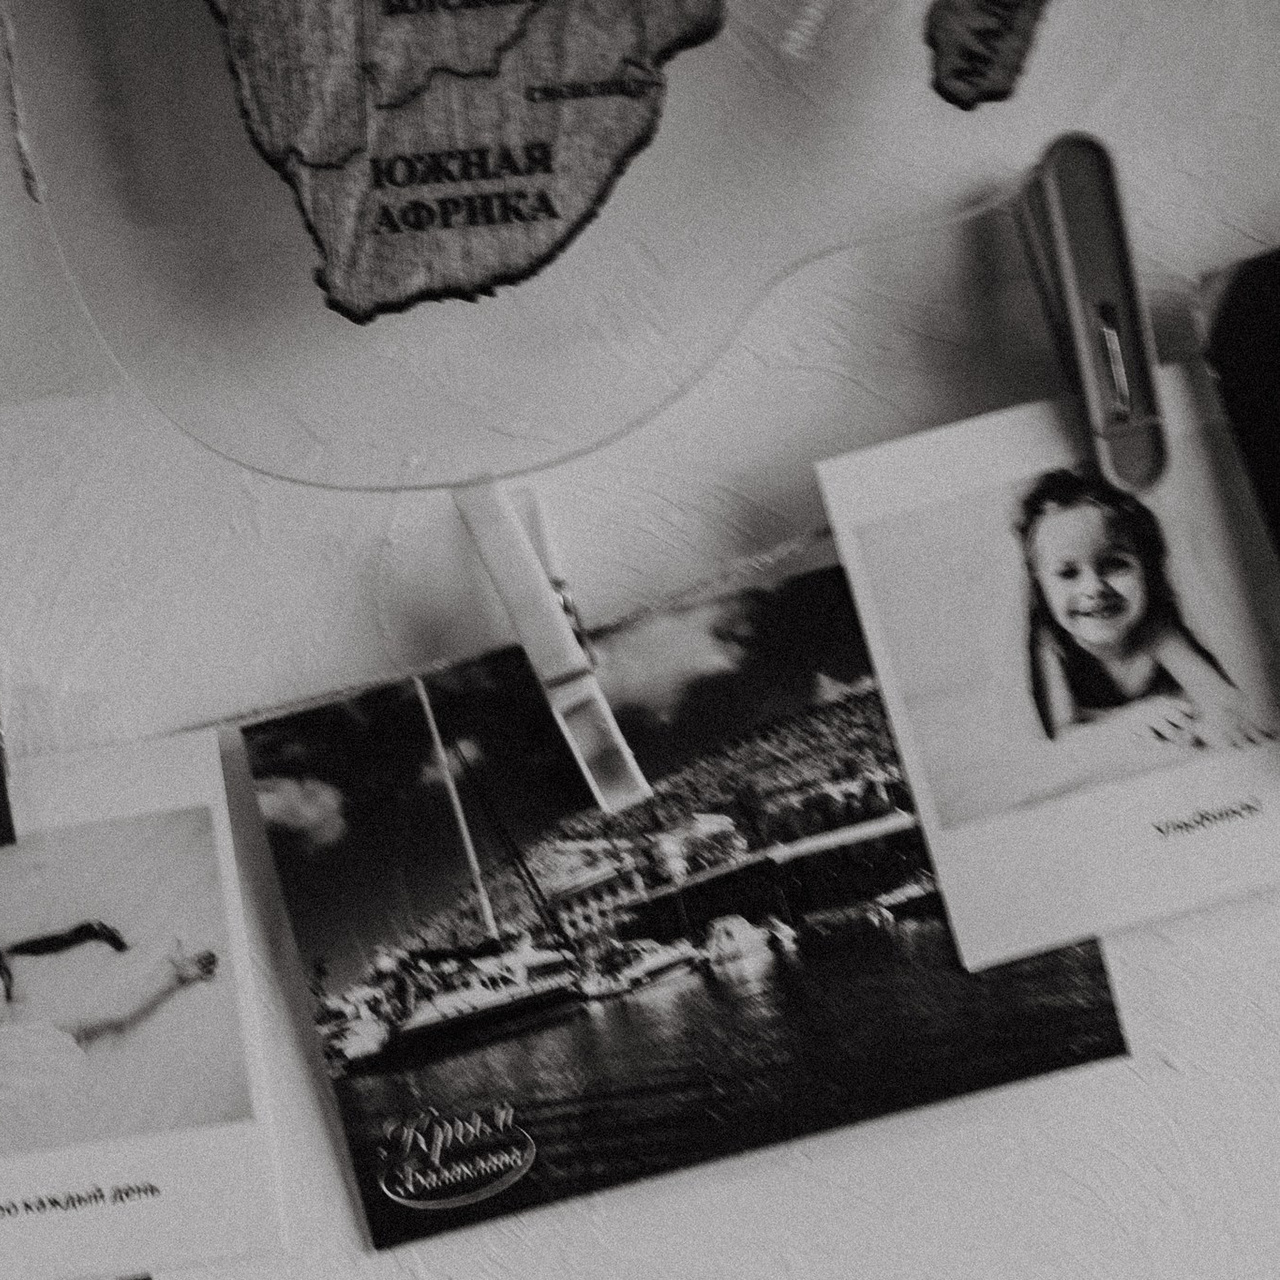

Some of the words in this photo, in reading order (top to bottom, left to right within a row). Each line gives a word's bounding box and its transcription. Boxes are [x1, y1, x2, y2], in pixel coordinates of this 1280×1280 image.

[370, 142, 554, 190] ЮЖНАЯ
[373, 190, 561, 235] АФРИКА
[21, 1185, 106, 1214] каждый
[108, 1181, 161, 1205] день
